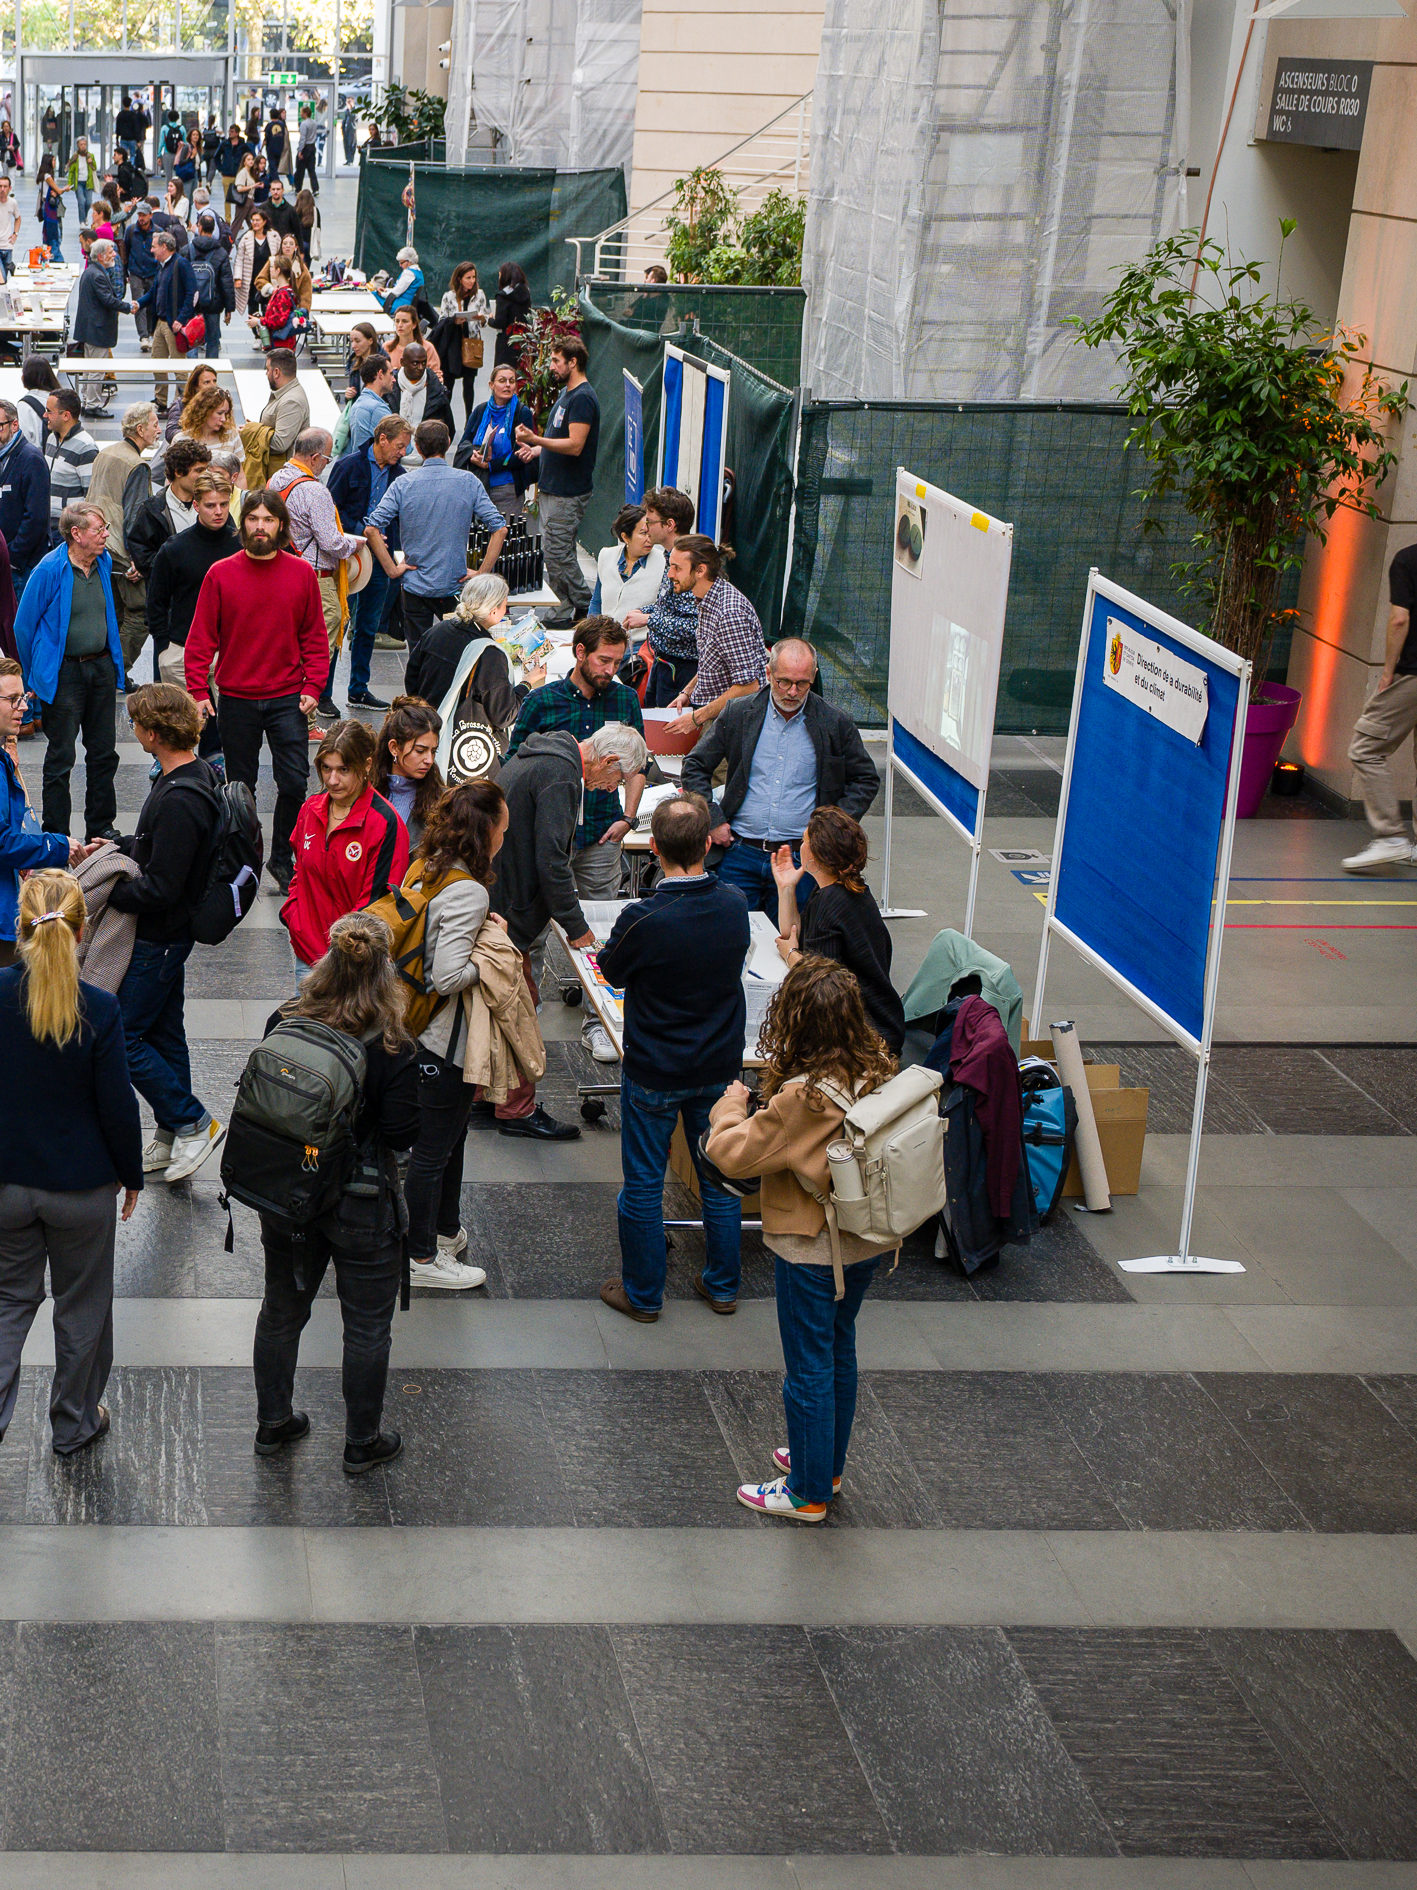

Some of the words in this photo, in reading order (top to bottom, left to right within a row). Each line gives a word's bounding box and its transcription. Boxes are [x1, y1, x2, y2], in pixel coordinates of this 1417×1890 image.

[1279, 71, 1328, 90] ASCENSEURS
[1329, 74, 1351, 92] BLOC
[1276, 93, 1298, 111] SALLE
[1298, 95, 1310, 112] DE
[1311, 96, 1338, 114] COURS
[1339, 98, 1360, 116] R030
[1273, 115, 1286, 132] WC
[1135, 674, 1140, 686] et
[1141, 677, 1148, 690] du
[1149, 683, 1165, 701] climat
[1136, 653, 1162, 678] Direction
[1163, 669, 1169, 682] de
[1174, 678, 1202, 703] durabilité
